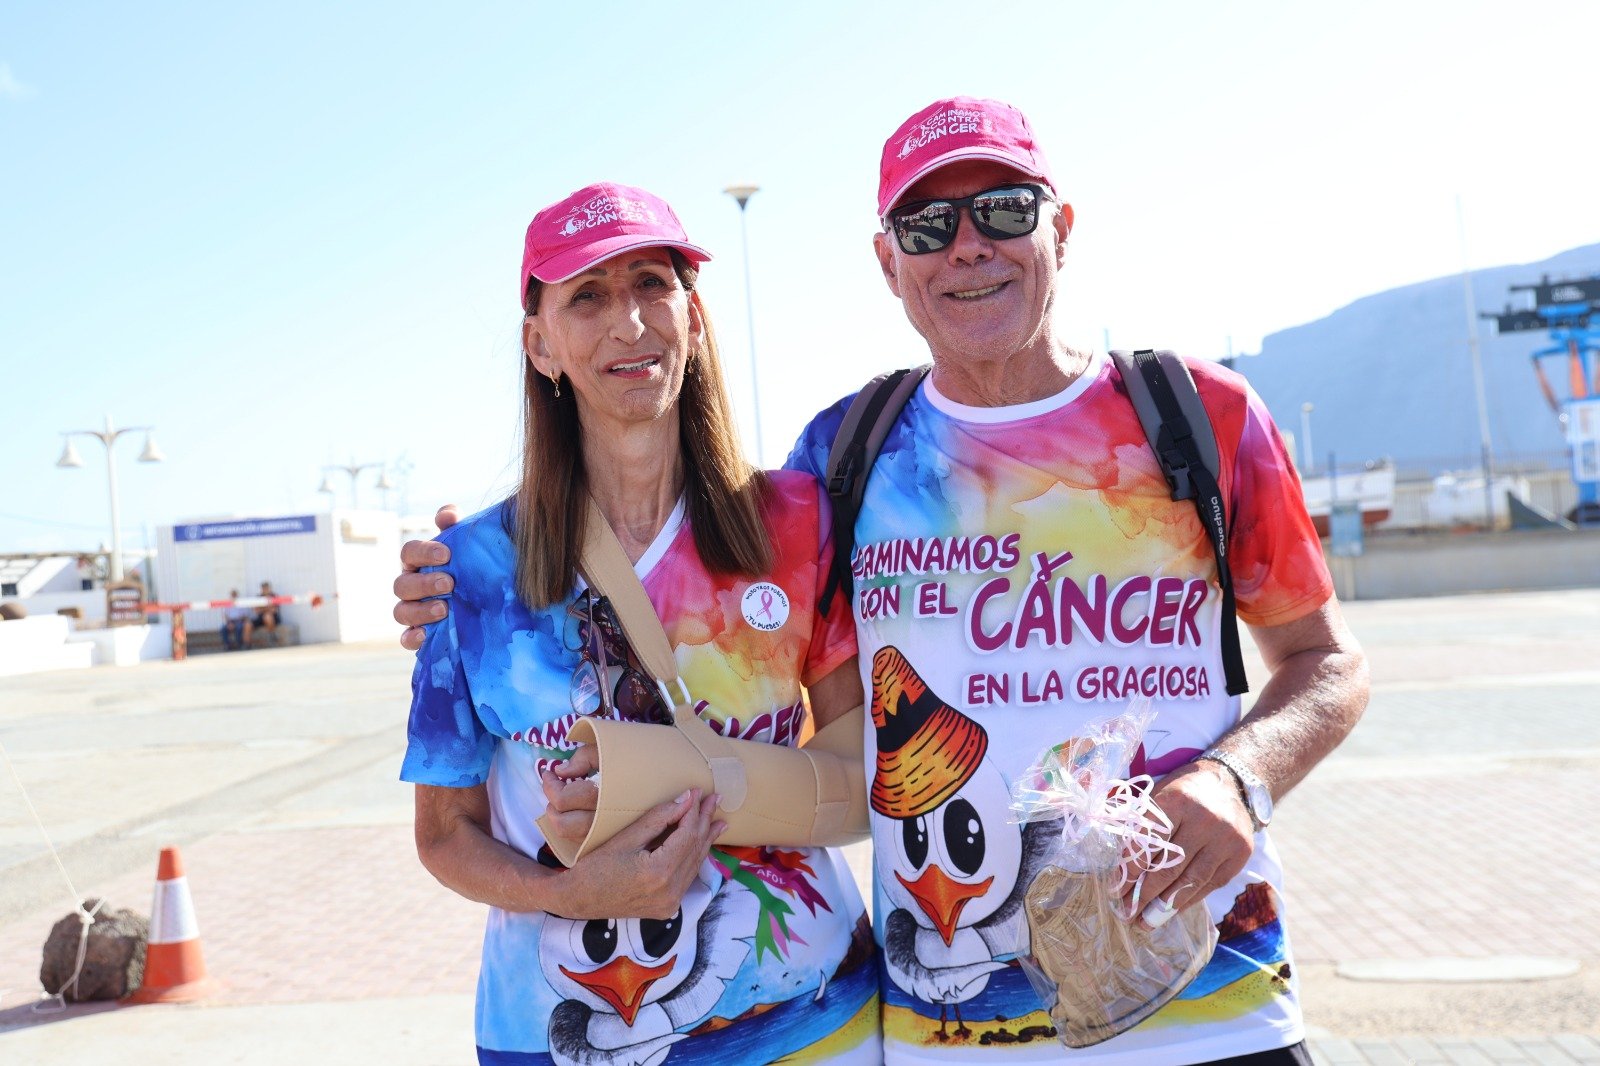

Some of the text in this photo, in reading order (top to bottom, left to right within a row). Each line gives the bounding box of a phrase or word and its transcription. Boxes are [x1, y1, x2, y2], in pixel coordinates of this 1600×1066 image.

[1211, 496, 1225, 557] Quechua
[852, 533, 1021, 578] CAMINAMOS
[861, 585, 900, 619] CON
[918, 583, 958, 615] EL
[968, 665, 1210, 704] EN LA GRACIOSA
